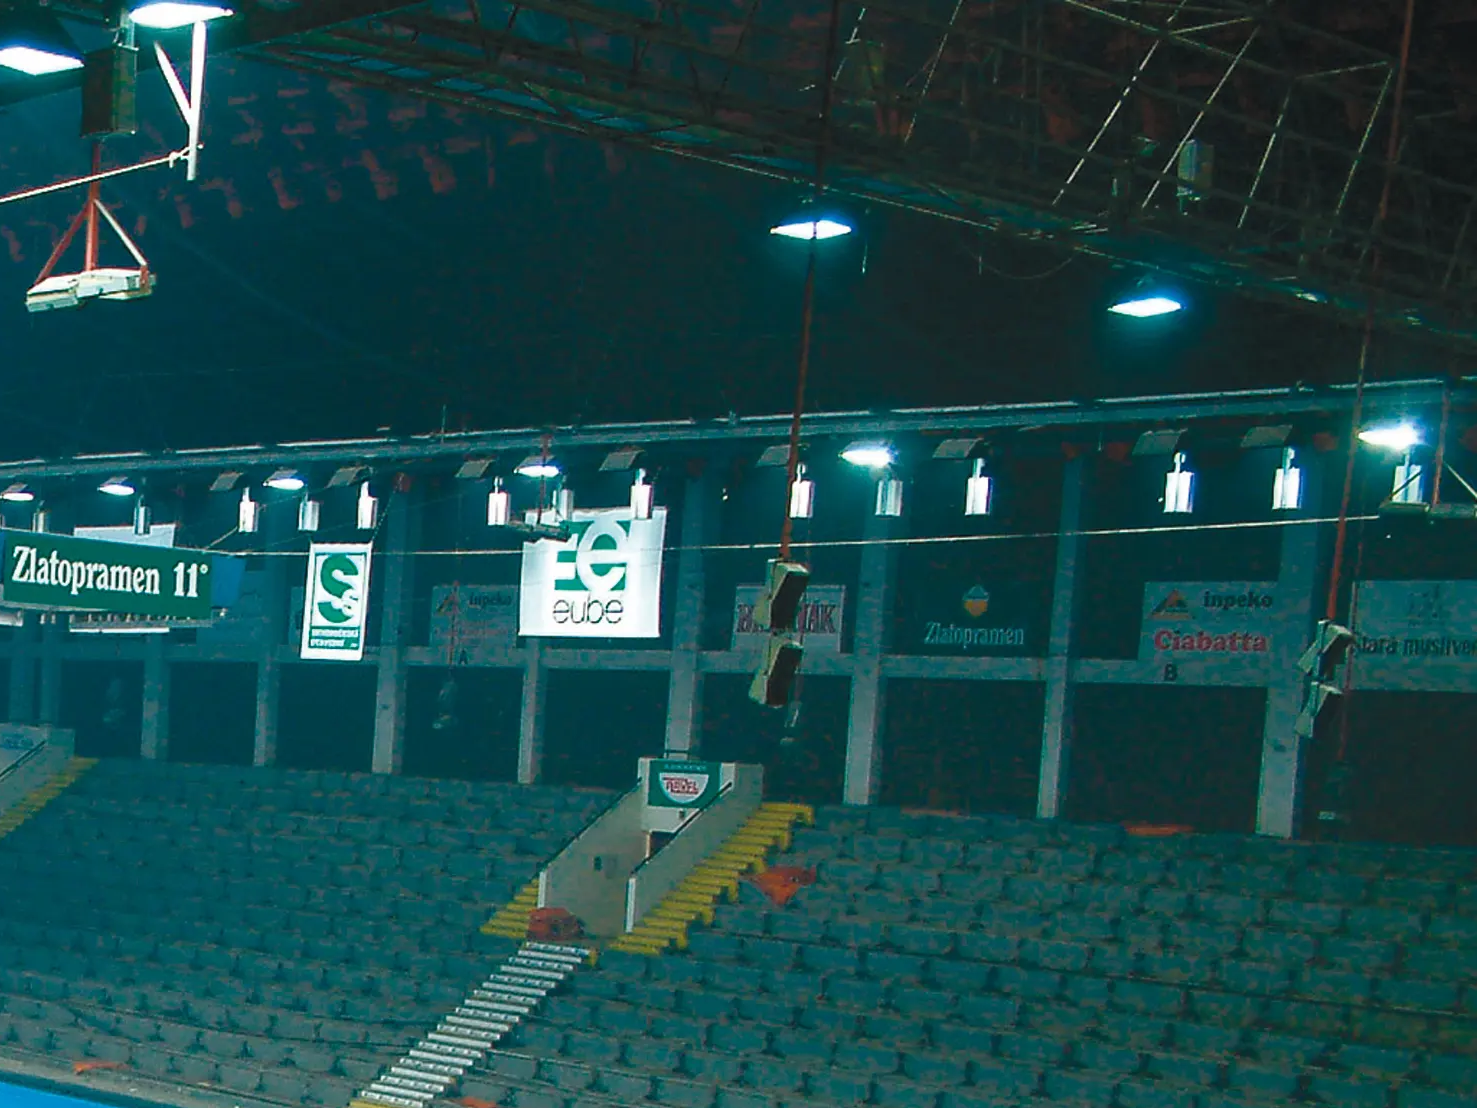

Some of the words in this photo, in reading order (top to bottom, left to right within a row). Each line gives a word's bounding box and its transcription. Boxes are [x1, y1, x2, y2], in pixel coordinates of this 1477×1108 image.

[11, 546, 160, 596] Zlatopramen
[552, 597, 623, 624] eube
[1203, 590, 1273, 610] inpeko
[924, 621, 1025, 650] Zlatopramen
[1154, 630, 1267, 652] Ciabatta
[1352, 635, 1400, 656] tará
[1164, 663, 1178, 681] B
